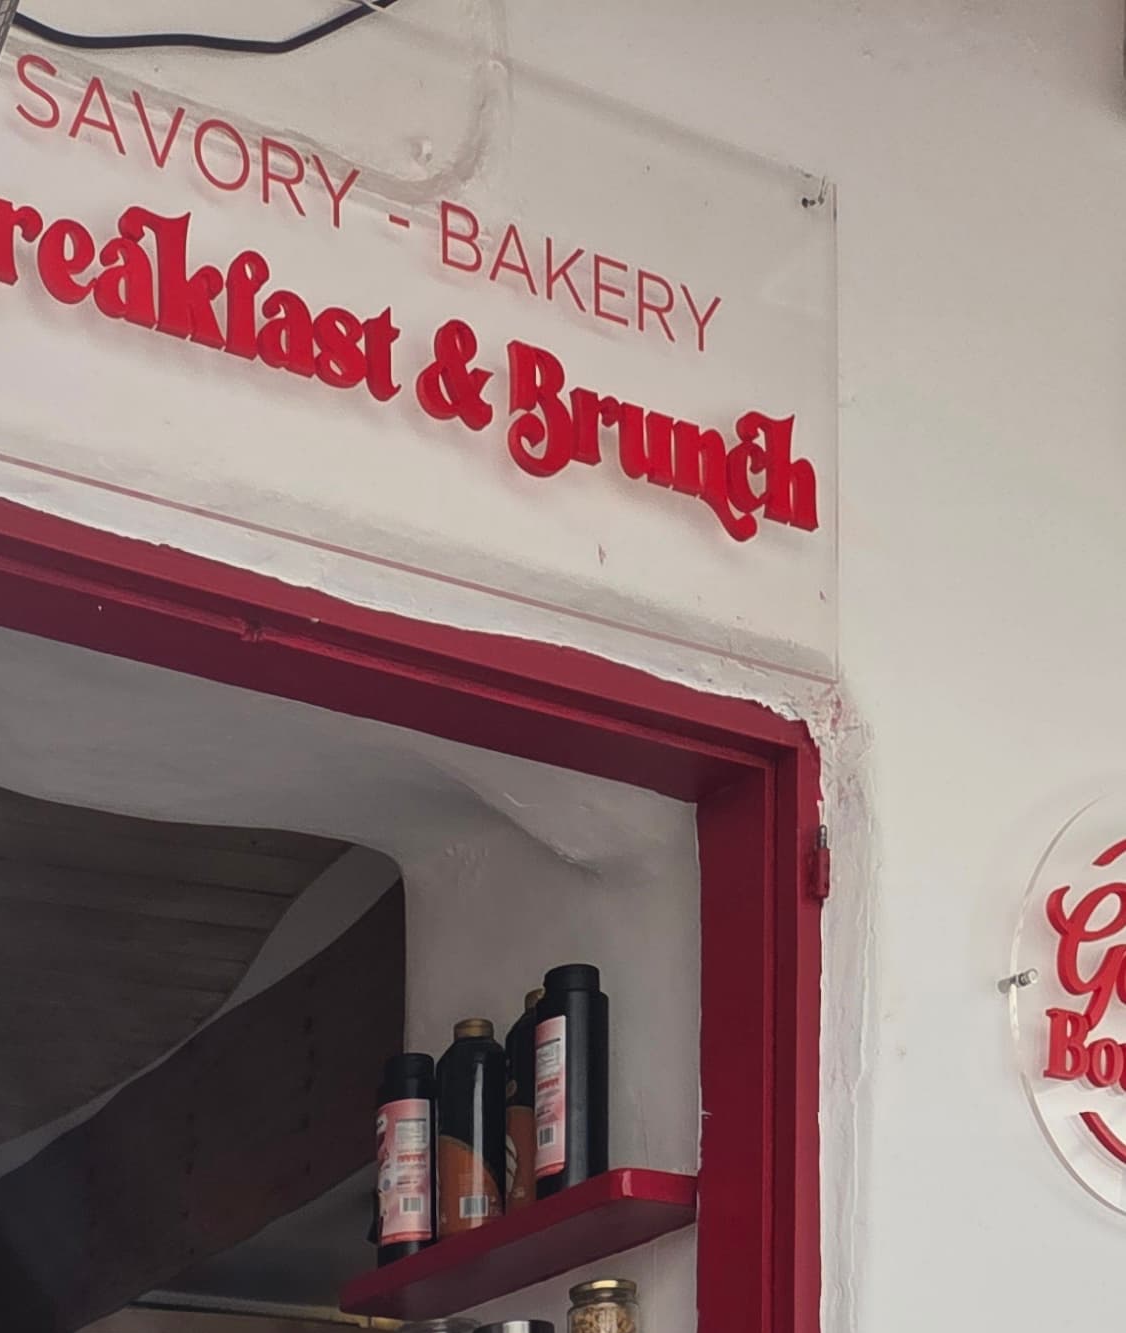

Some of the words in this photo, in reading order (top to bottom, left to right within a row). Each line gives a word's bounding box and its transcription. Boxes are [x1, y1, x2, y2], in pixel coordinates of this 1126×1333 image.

[14, 52, 361, 229] SAVORY
[439, 199, 722, 353] BAKERY
[416, 318, 492, 430] &
[506, 339, 819, 541] Brunch
